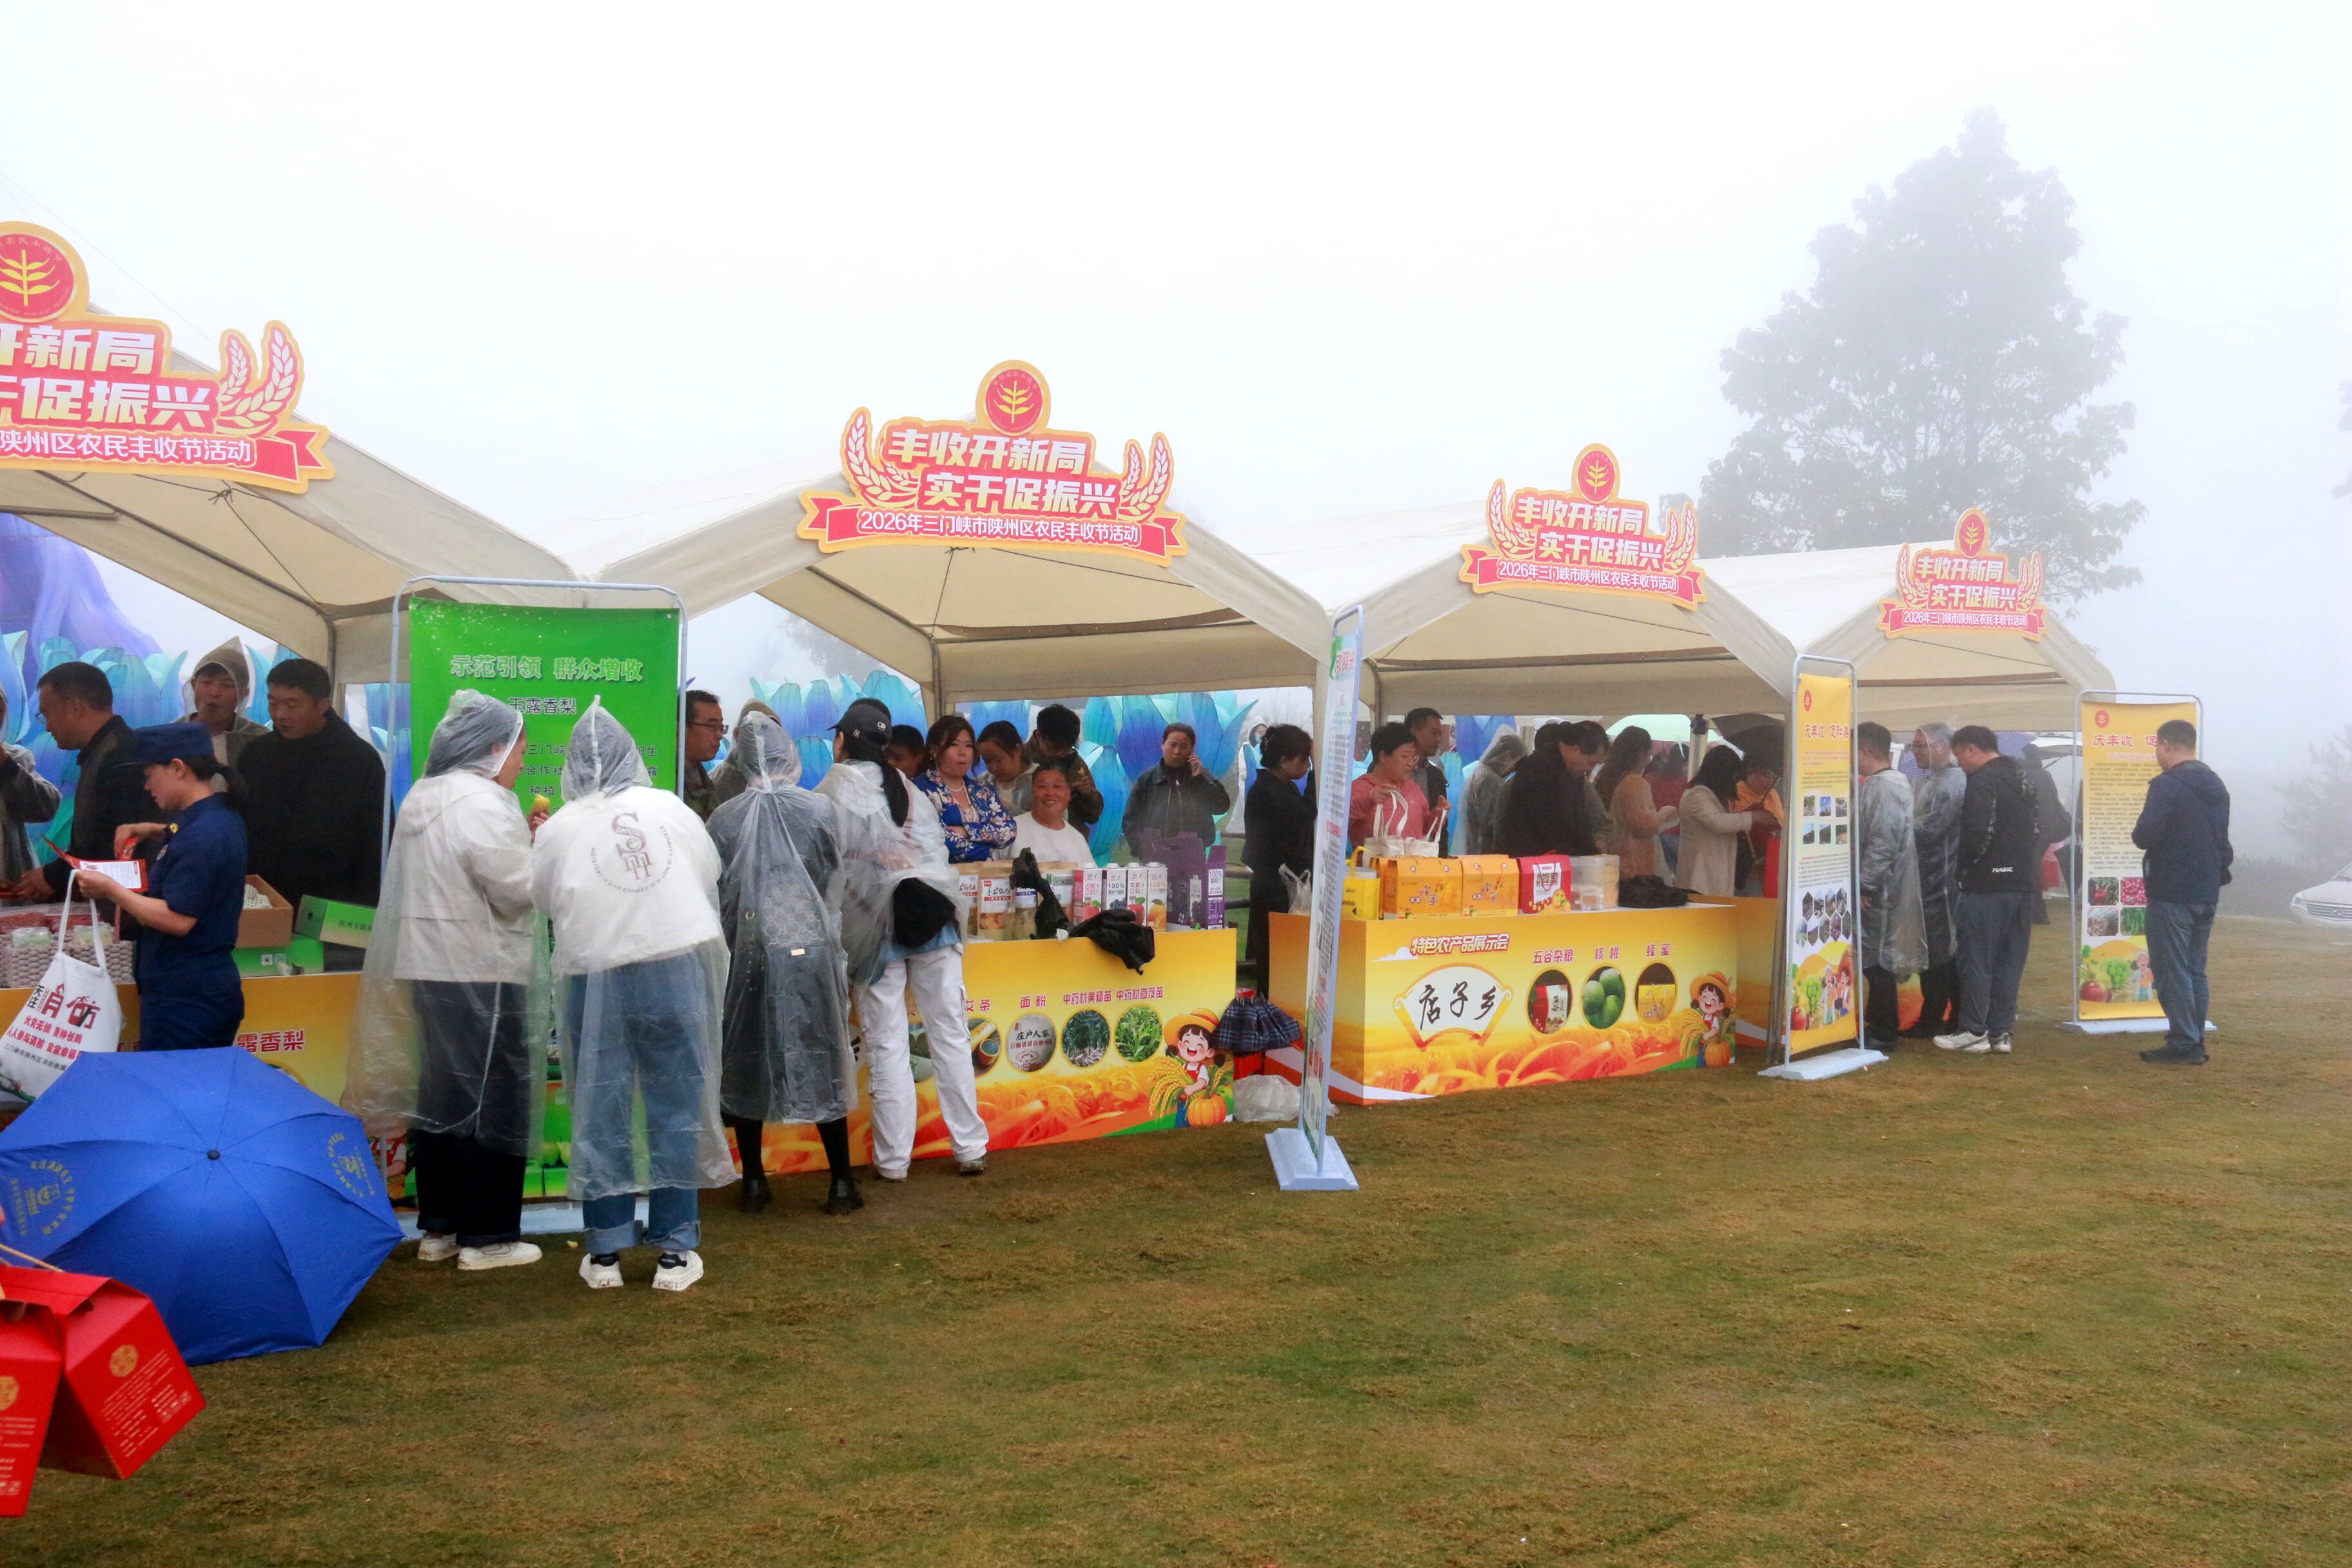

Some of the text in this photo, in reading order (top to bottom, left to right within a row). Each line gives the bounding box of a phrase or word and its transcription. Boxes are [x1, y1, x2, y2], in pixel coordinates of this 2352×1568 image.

[0, 375, 210, 427] 促振兴
[0, 431, 251, 462] 陕州区农民丰收节活动
[888, 428, 1087, 475] 丰收开新局
[923, 473, 1117, 514] 实干促振兴
[861, 511, 1139, 542] 2026年三门峡市陕州区农民丰收节活动
[1515, 496, 1645, 536] 丰收开新局
[1538, 531, 1663, 569] 实干促振兴
[1498, 561, 1677, 591] 2026年三门峡市陕州区农民丰收节活动
[1916, 556, 2004, 582] 丰收开新局
[1930, 584, 2017, 609] 实干促振兴
[1904, 611, 2027, 627] 2026年三门峡市陕州区农民丰收节活动
[450, 654, 644, 681] 示范引领 群众增收
[527, 744, 565, 756] 三门峡
[2093, 734, 2133, 747] 庆丰收
[518, 765, 562, 776] 合作社
[530, 785, 562, 796] 种植
[1410, 933, 1510, 956] 特色农产品展示会
[1532, 949, 1574, 965] 五谷杂粮
[1594, 946, 1620, 960] 核桃
[1019, 995, 1046, 1008] 面粉
[1063, 990, 1112, 1005] 中药材黄精苗
[1418, 981, 1496, 1030] 店子乡
